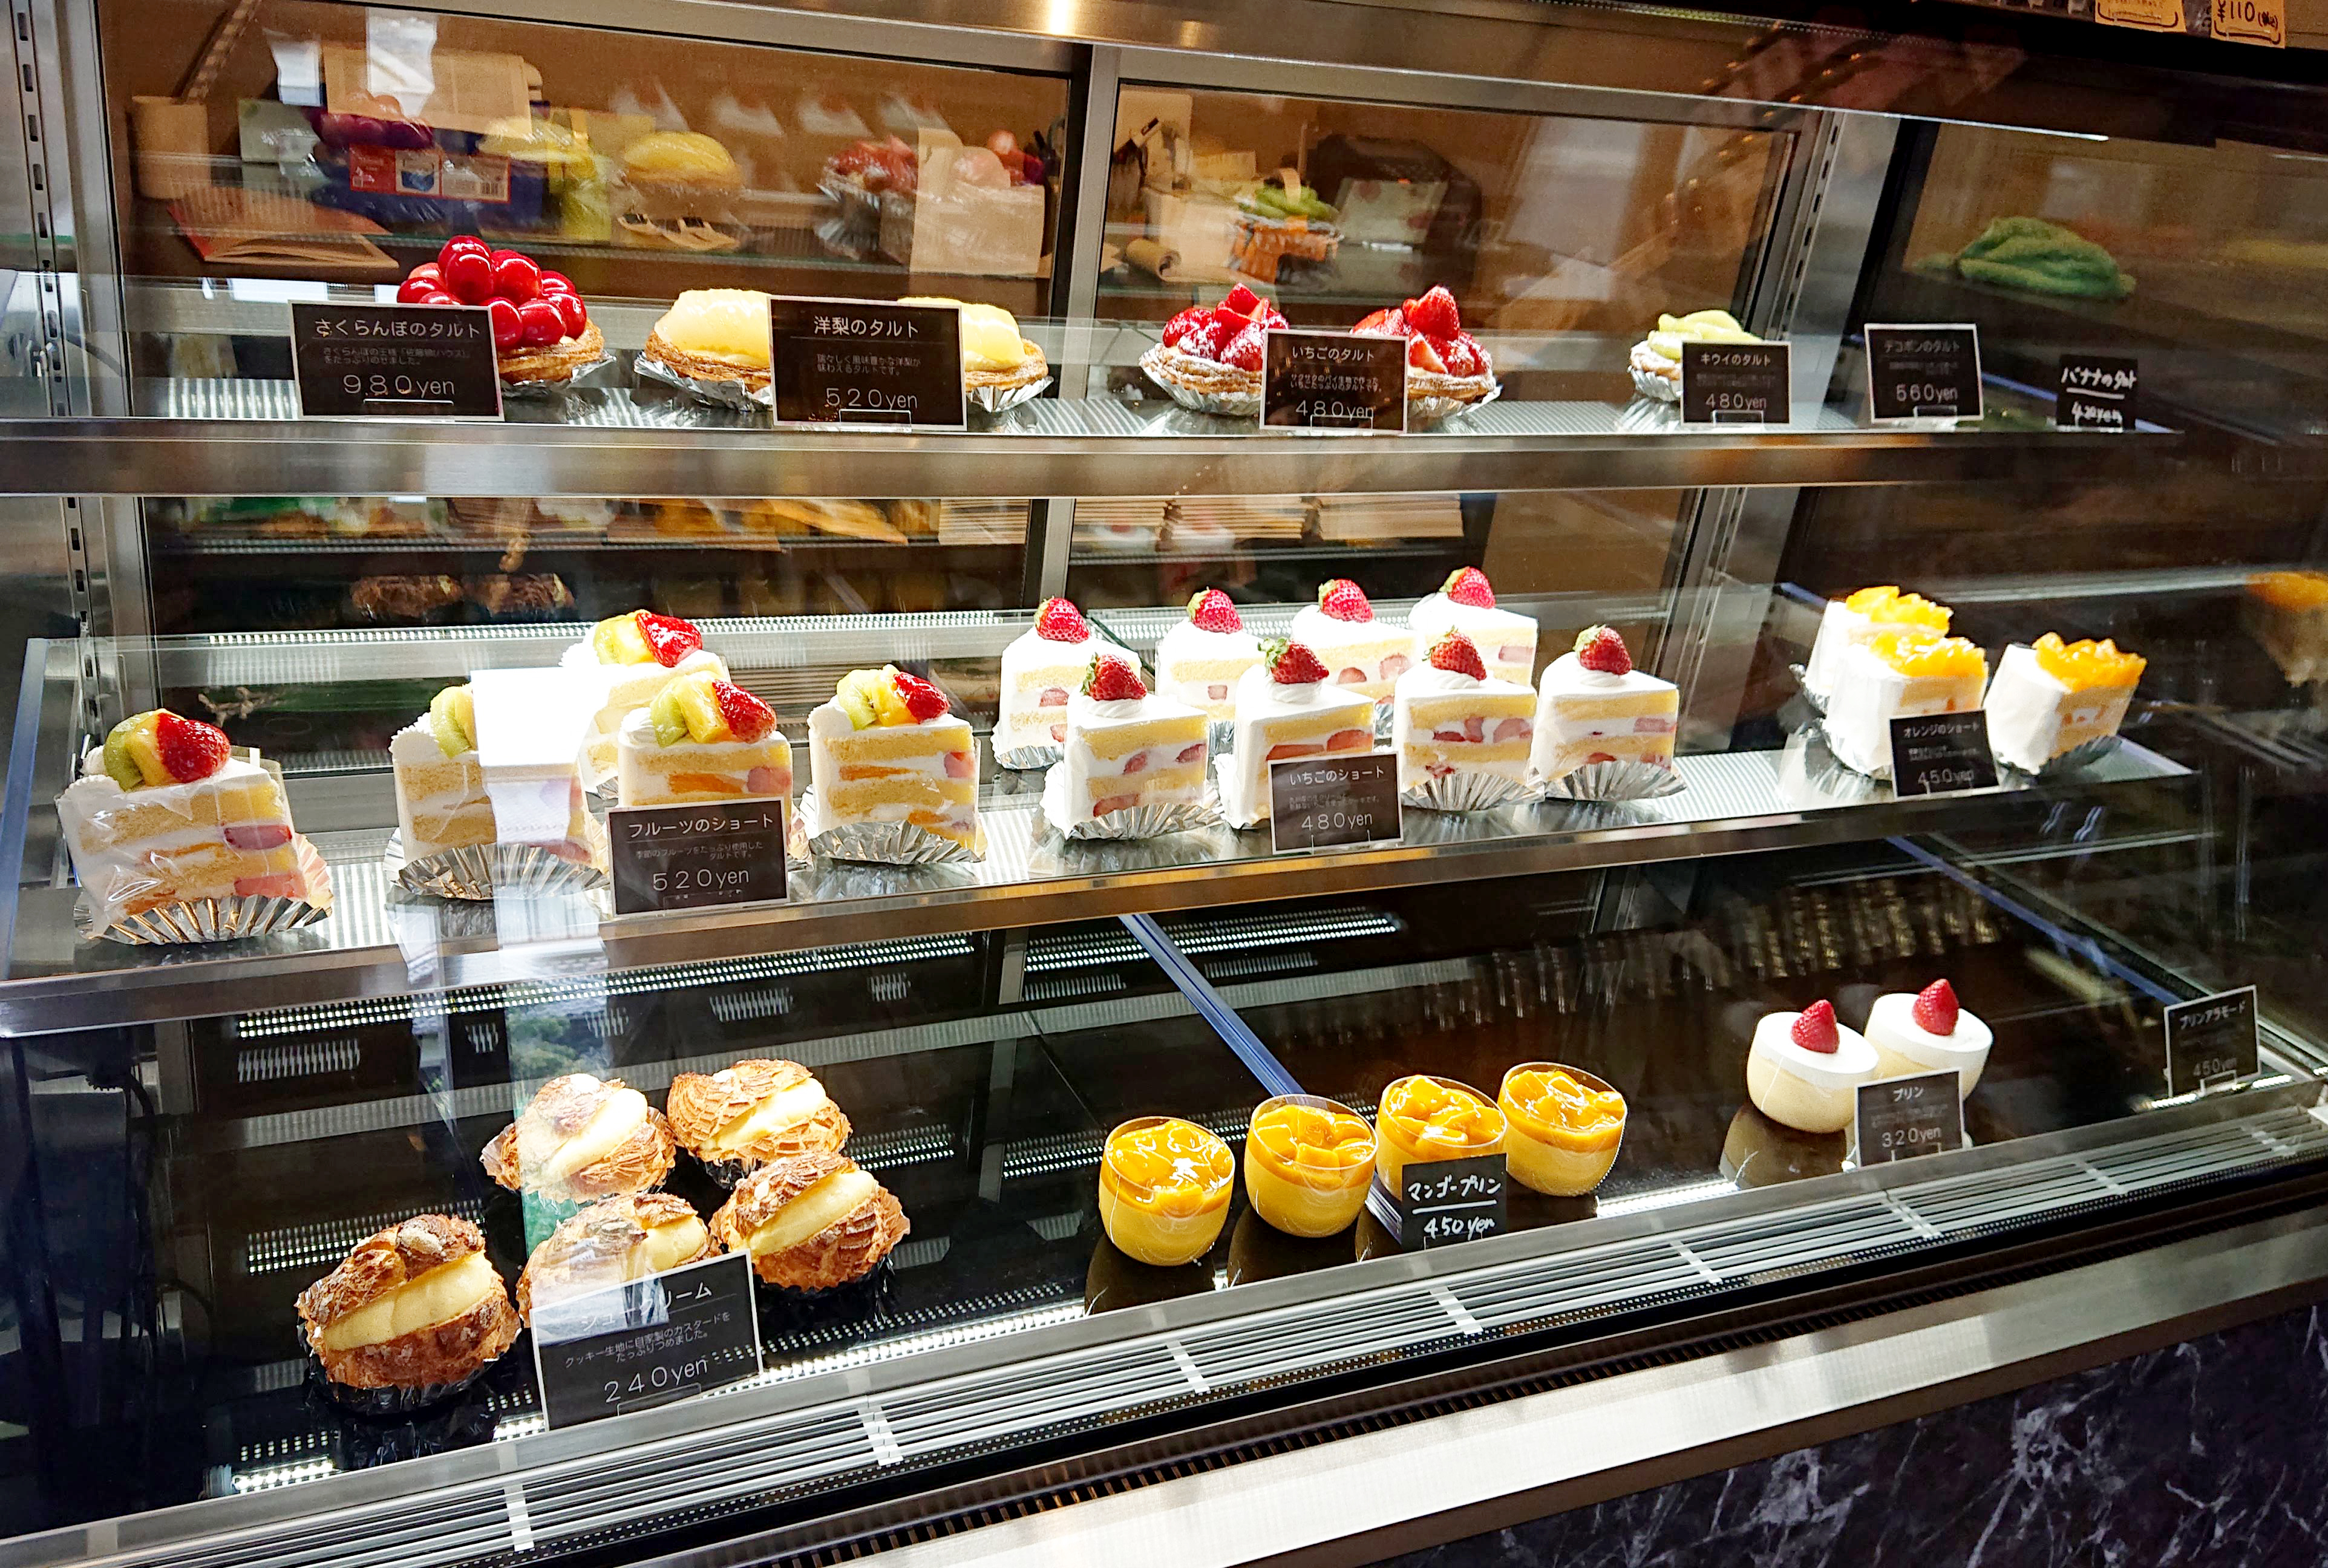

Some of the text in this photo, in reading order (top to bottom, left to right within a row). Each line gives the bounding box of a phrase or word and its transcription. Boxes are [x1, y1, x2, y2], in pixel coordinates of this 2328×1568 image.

[315, 318, 480, 339] さくらんぼのタルト
[814, 315, 919, 339] 洋梨のタルト
[1292, 346, 1375, 362] いちごのタルト
[1700, 351, 1771, 368] キウイのタルト
[343, 374, 454, 398] 980yen
[826, 388, 918, 411] 520yen
[1705, 393, 1767, 411] 480yen
[1295, 400, 1374, 422] 480yen
[1290, 765, 1384, 785] いちごのショート
[629, 814, 773, 838] フルーツのショート
[1301, 812, 1372, 831] 480yen
[653, 869, 749, 891] 520yen
[1893, 1086, 1924, 1102] プリン
[1882, 1127, 1941, 1148] 320yen
[1408, 1174, 1502, 1201] マンゴープリン
[1424, 1216, 1495, 1241] 450yen
[605, 1358, 708, 1403] 240yen
